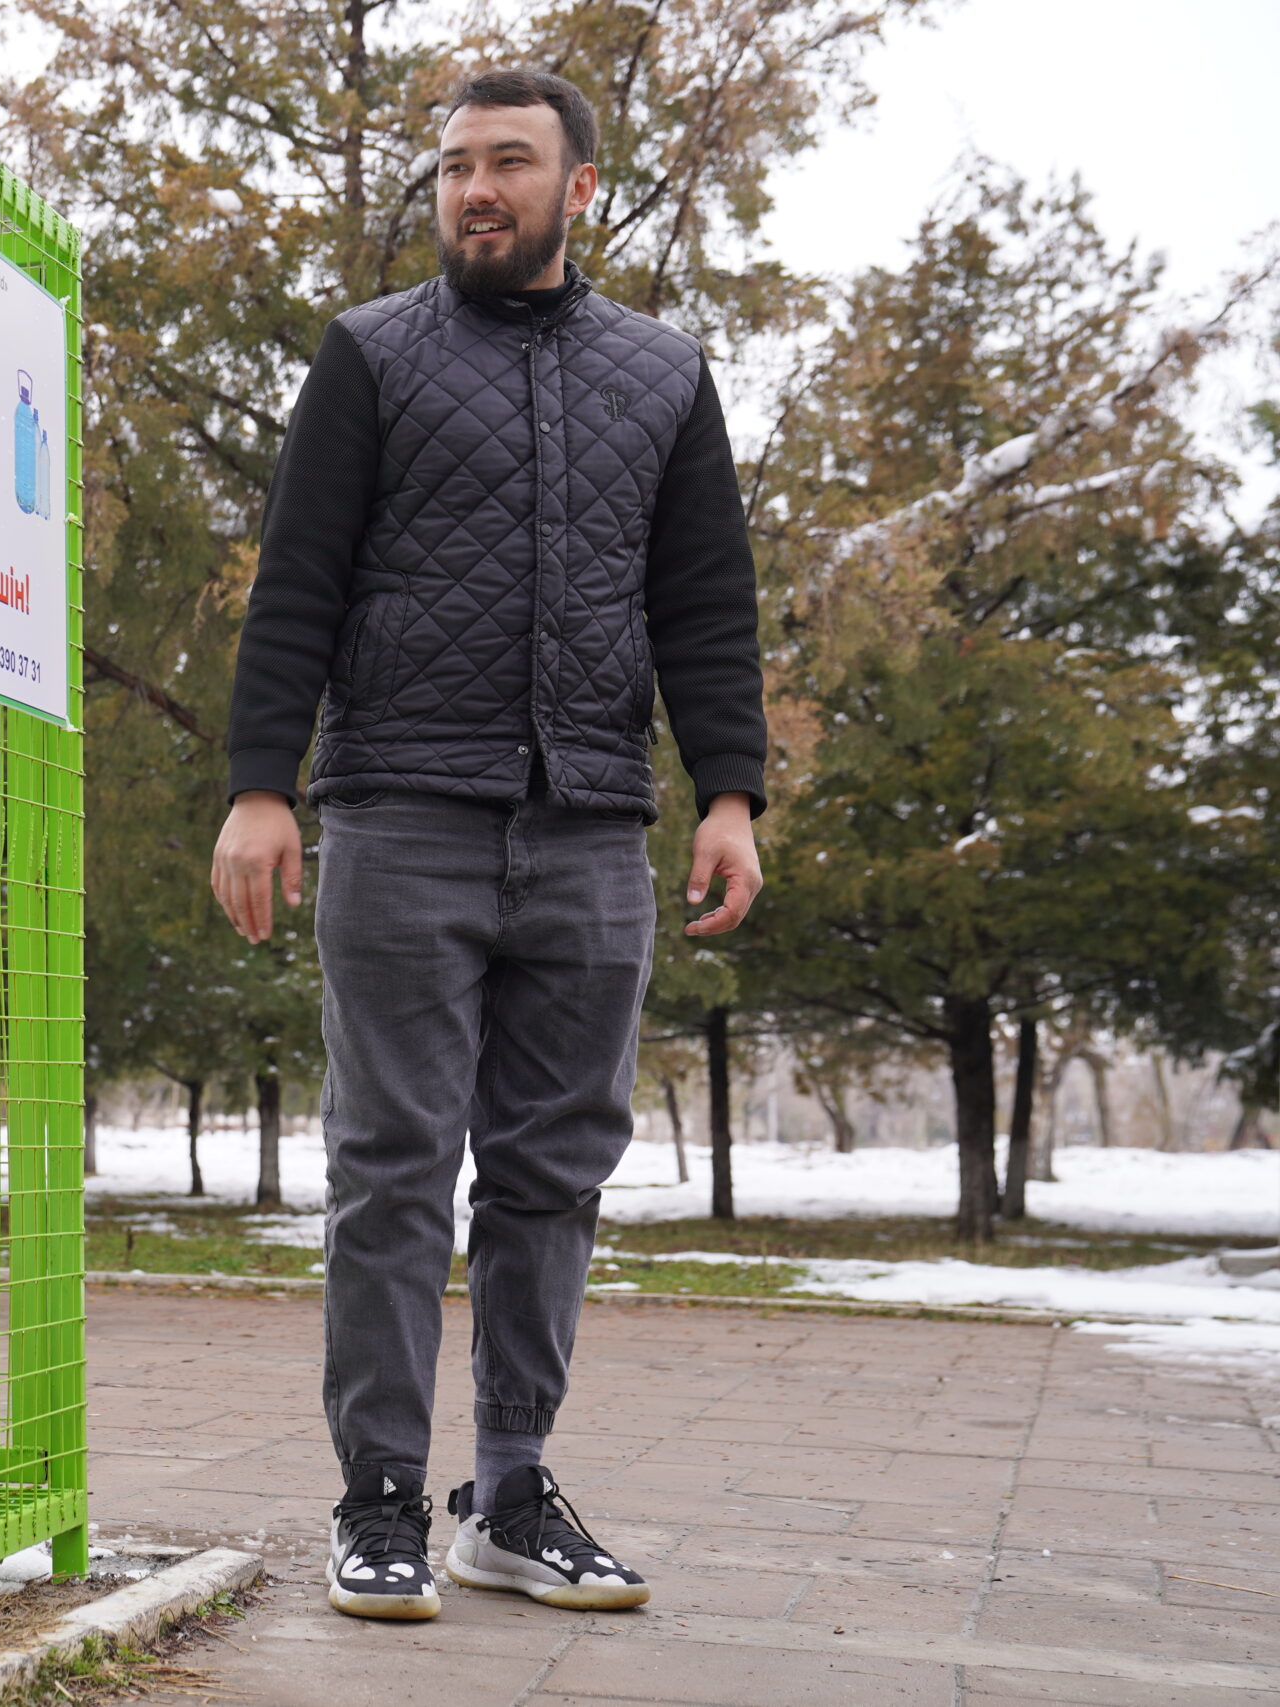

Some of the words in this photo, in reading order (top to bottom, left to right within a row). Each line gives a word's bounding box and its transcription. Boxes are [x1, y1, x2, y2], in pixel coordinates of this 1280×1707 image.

[0, 646, 16, 673] 390
[18, 653, 29, 680] 37
[31, 660, 41, 684] 31
